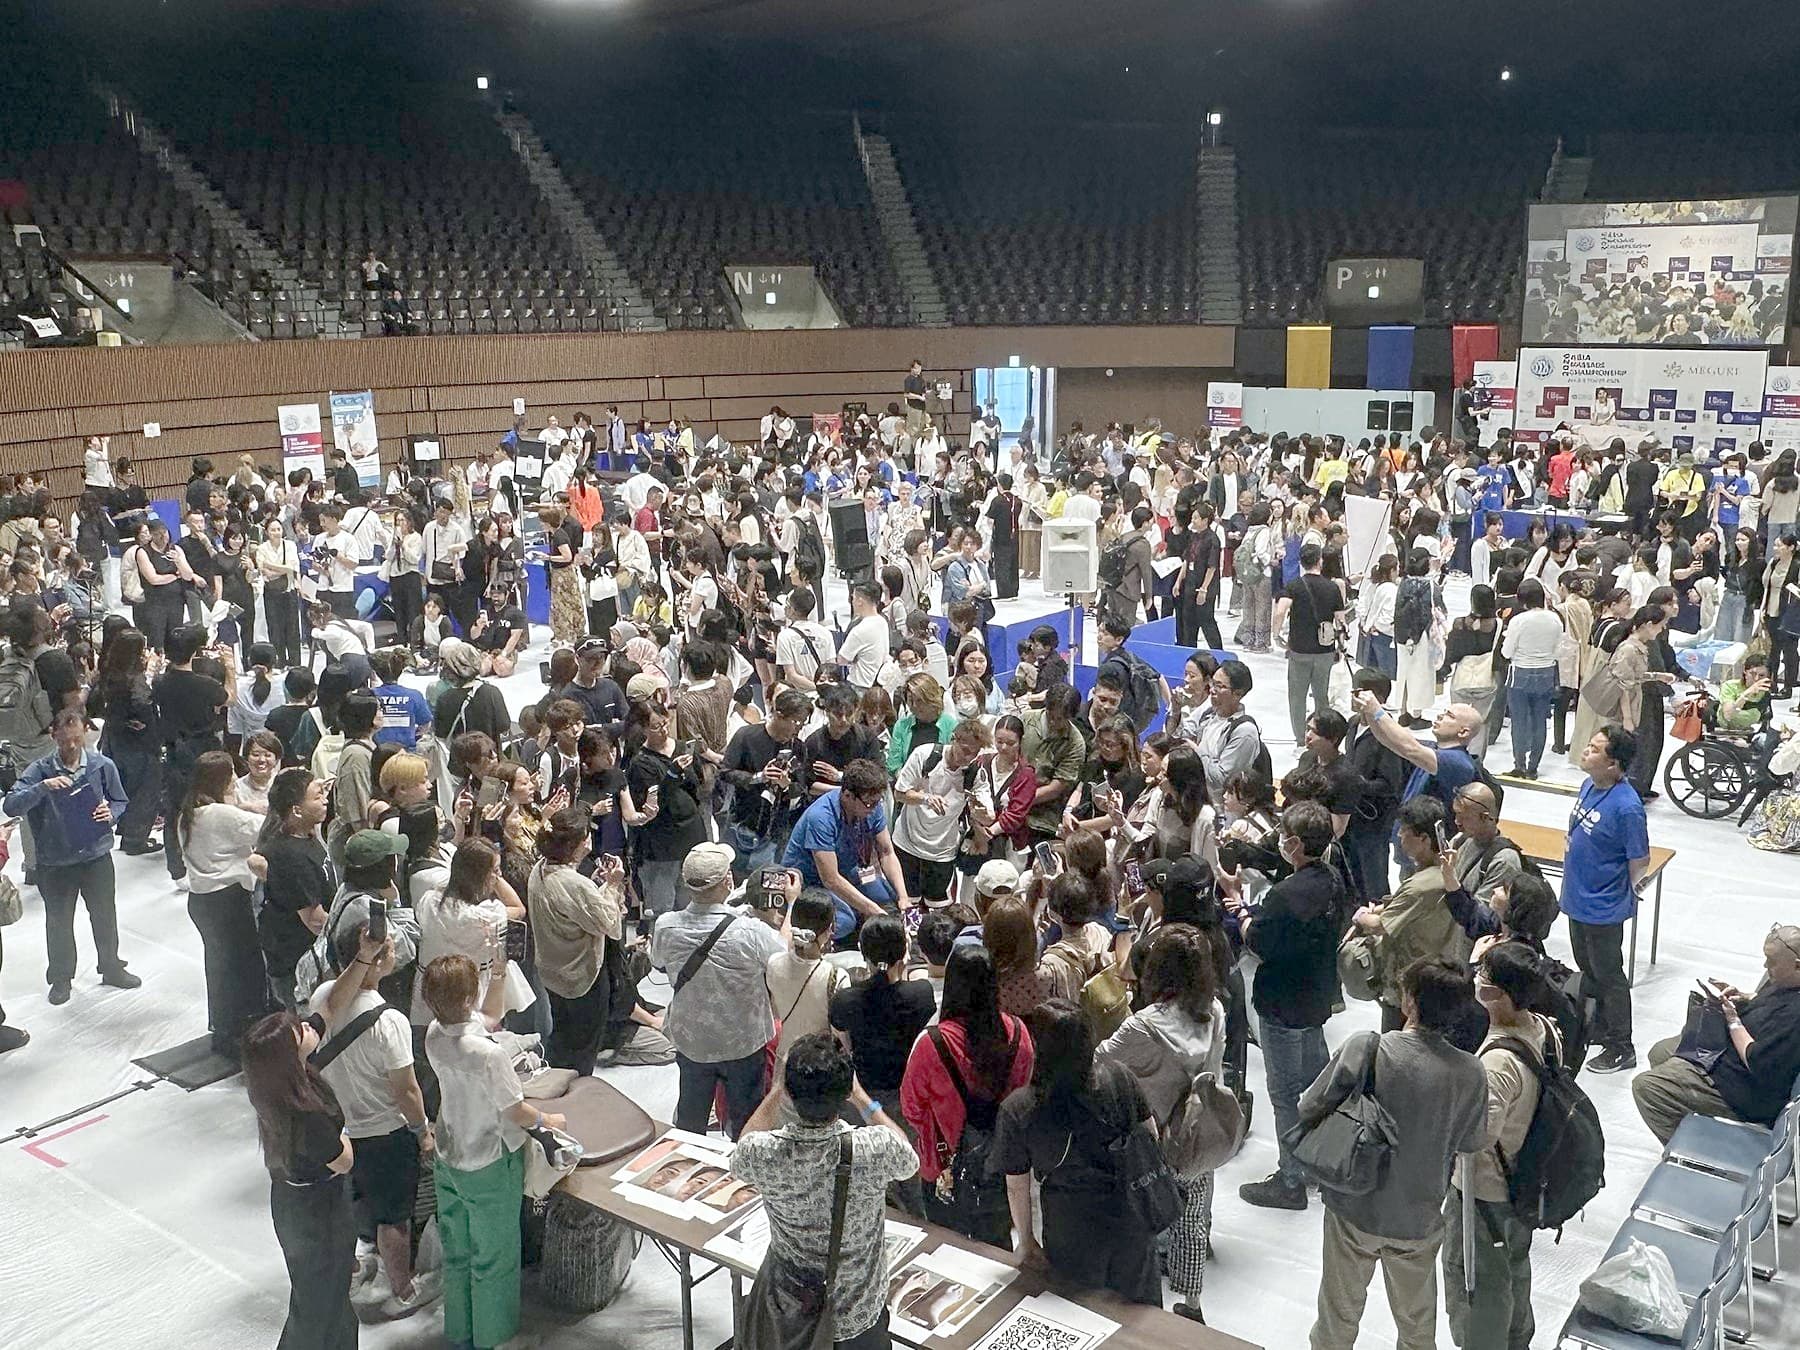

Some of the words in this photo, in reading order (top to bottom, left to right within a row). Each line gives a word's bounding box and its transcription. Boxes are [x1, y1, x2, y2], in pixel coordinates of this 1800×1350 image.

[734, 271, 753, 295] N
[1337, 267, 1353, 290] P
[1688, 366, 1740, 376] MEGURI
[381, 695, 410, 705] TAFF
